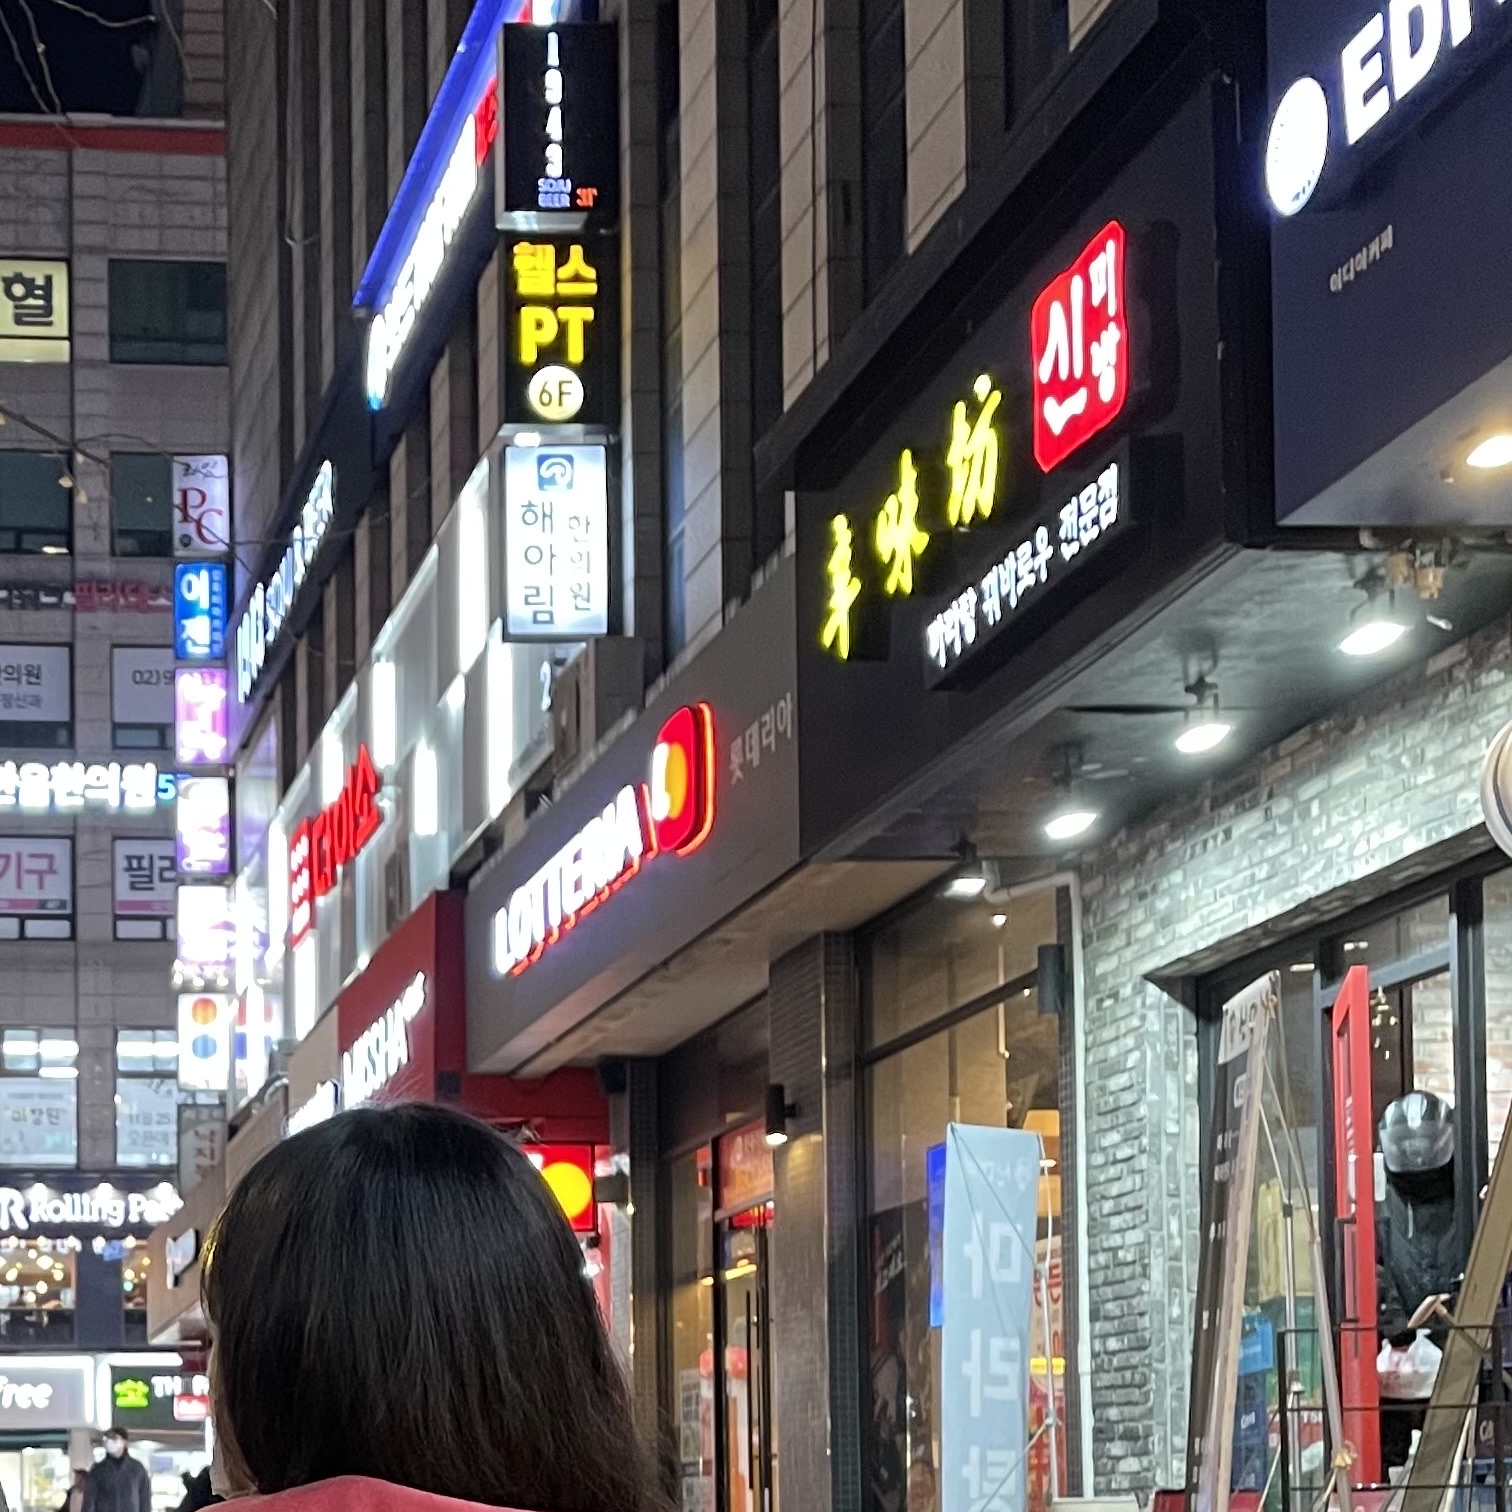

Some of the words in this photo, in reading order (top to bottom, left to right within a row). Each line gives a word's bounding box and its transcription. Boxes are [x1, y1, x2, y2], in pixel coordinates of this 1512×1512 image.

[512, 242, 598, 297] 헬스
[519, 305, 595, 364] PT
[538, 380, 573, 408] 6F
[520, 500, 555, 625] 해아림
[729, 691, 793, 785] 롯데리아
[494, 784, 644, 975] LOTTERIA
[29, 1192, 125, 1227] Rolling
